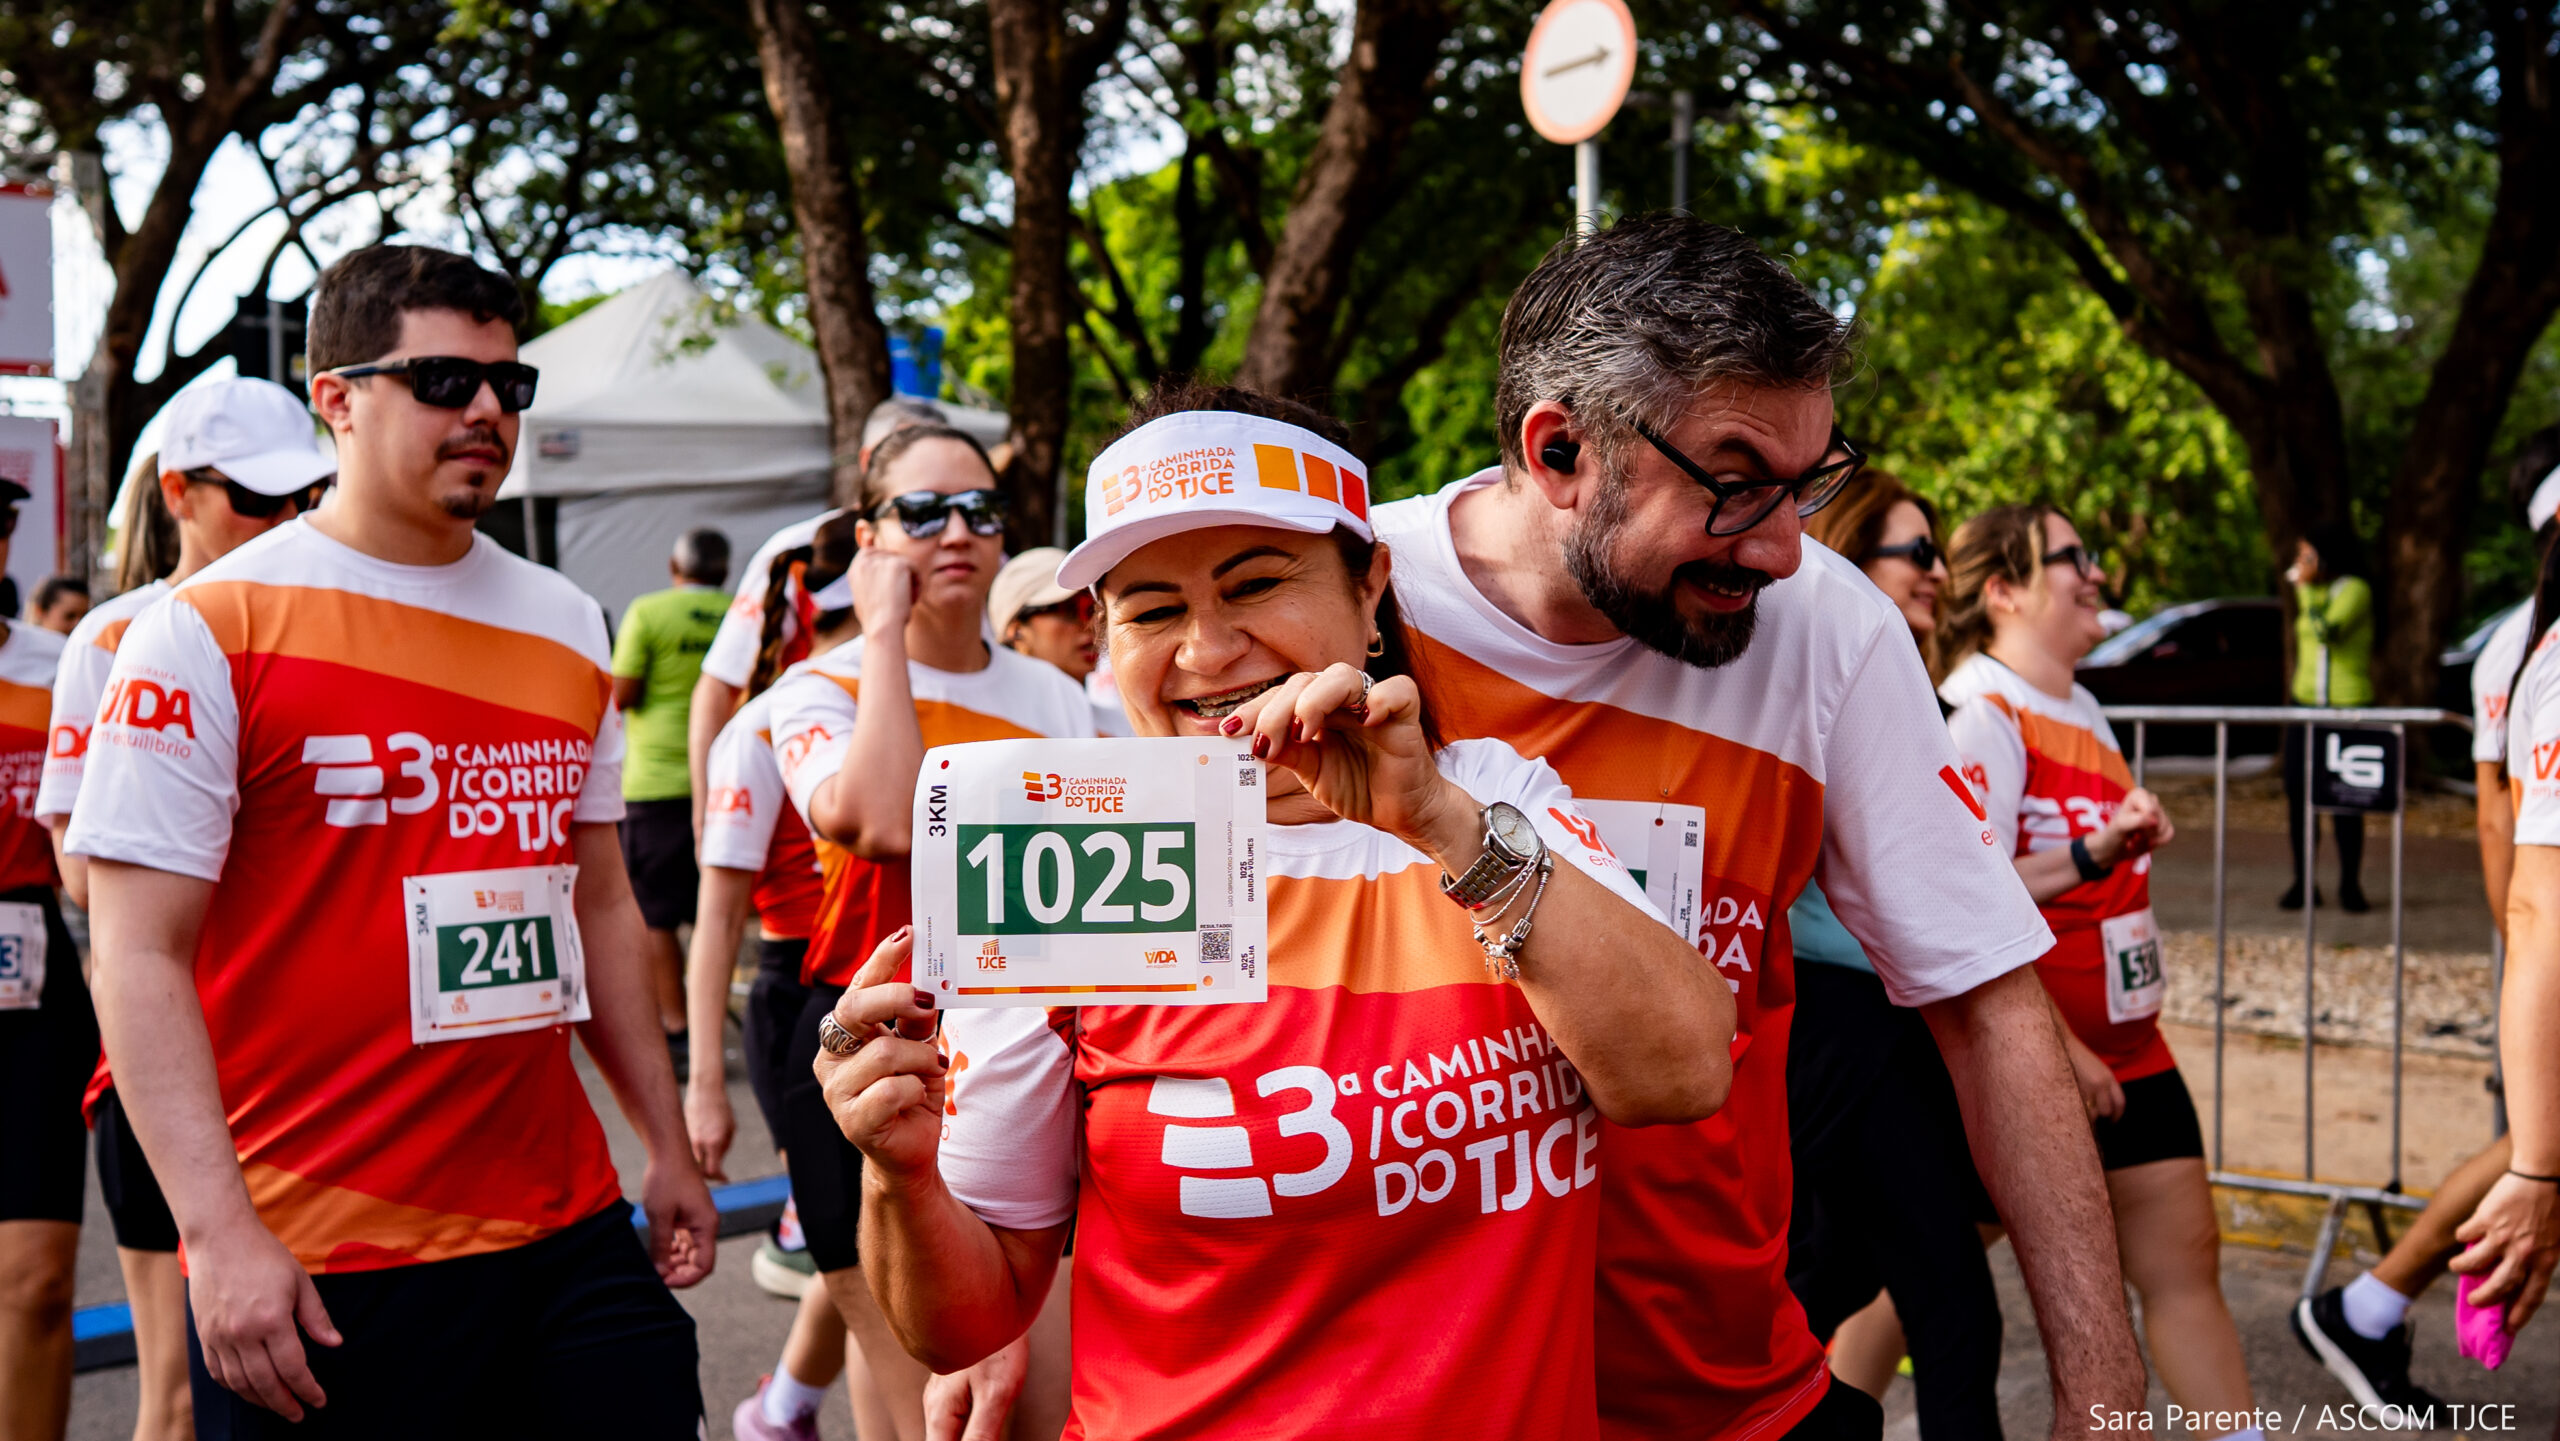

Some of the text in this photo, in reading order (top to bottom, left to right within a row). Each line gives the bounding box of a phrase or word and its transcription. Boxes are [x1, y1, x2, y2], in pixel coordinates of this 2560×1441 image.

[1146, 458, 1235, 488] /CORRIDA
[1149, 446, 1236, 471] CAMINHADA
[1148, 472, 1235, 503] DO TJCE
[1237, 753, 1256, 762] 1025
[448, 764, 584, 801] /CORRID
[1065, 785, 1126, 796] /CORRIDA
[1068, 776, 1128, 786] CAMINHADA
[928, 784, 948, 838] 3KM
[1065, 796, 1124, 813] DO TJCE
[449, 798, 573, 852] DO TJC
[966, 830, 1191, 924] 1025
[1240, 861, 1248, 879] 1025
[1247, 837, 1255, 902] GUARDA-VOLUMES
[458, 920, 542, 986] 241
[976, 956, 1007, 969] TJCE
[1144, 950, 1178, 964] VIDA
[1240, 953, 1249, 971] 1025
[1369, 1059, 1582, 1161] /CORRID
[1374, 1104, 1599, 1217] DO TJCE
